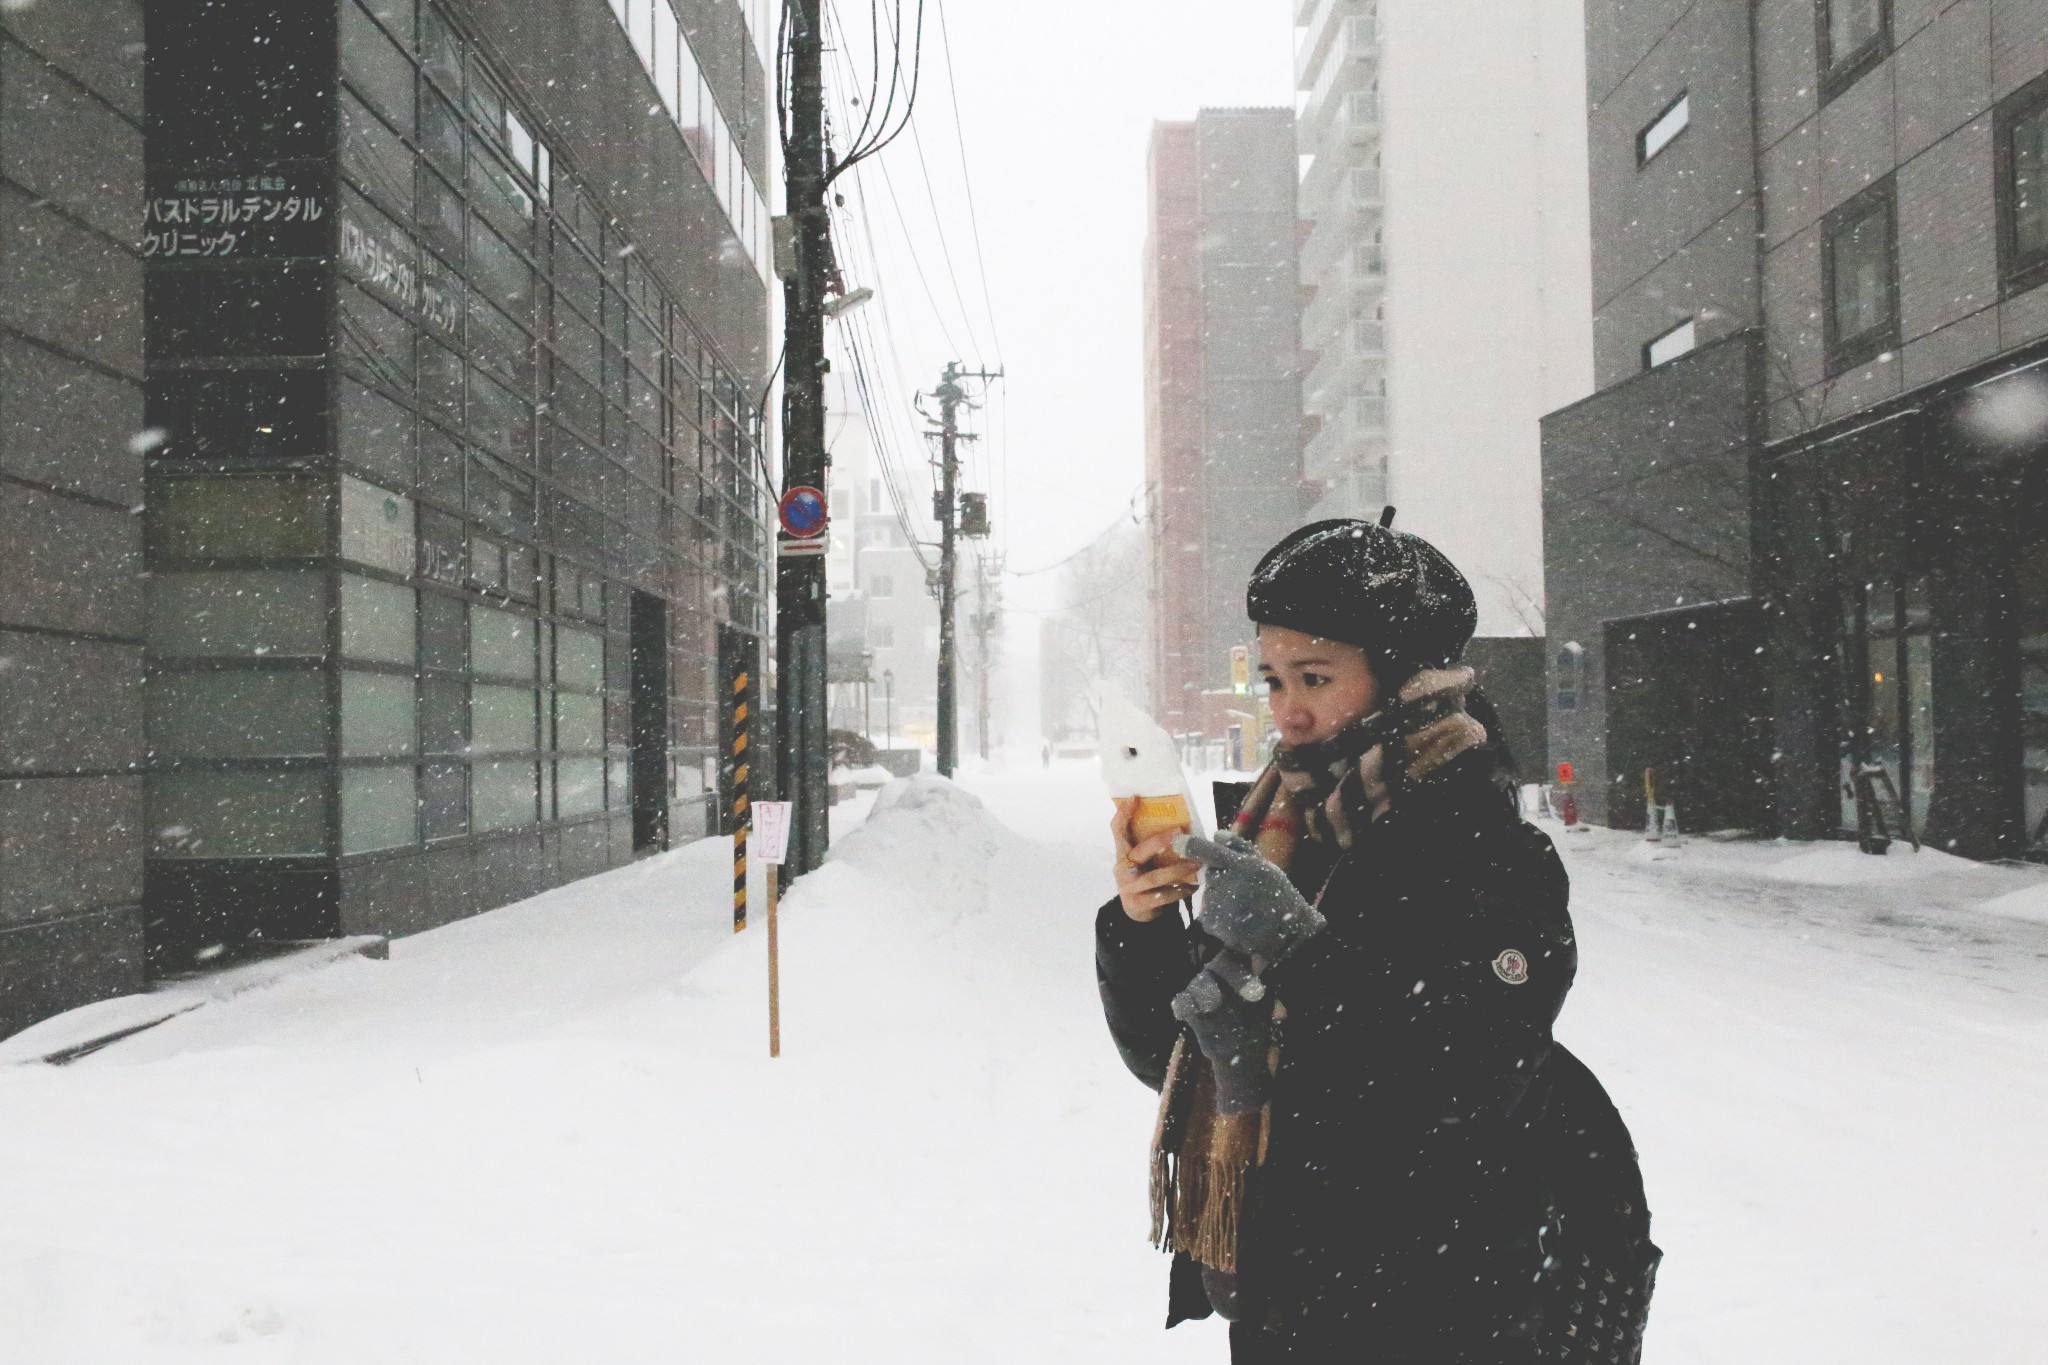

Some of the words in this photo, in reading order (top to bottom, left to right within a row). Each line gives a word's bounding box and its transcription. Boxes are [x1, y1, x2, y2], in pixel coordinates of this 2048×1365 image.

[143, 196, 322, 223] パストラルデンタル
[143, 229, 236, 257] クリニック
